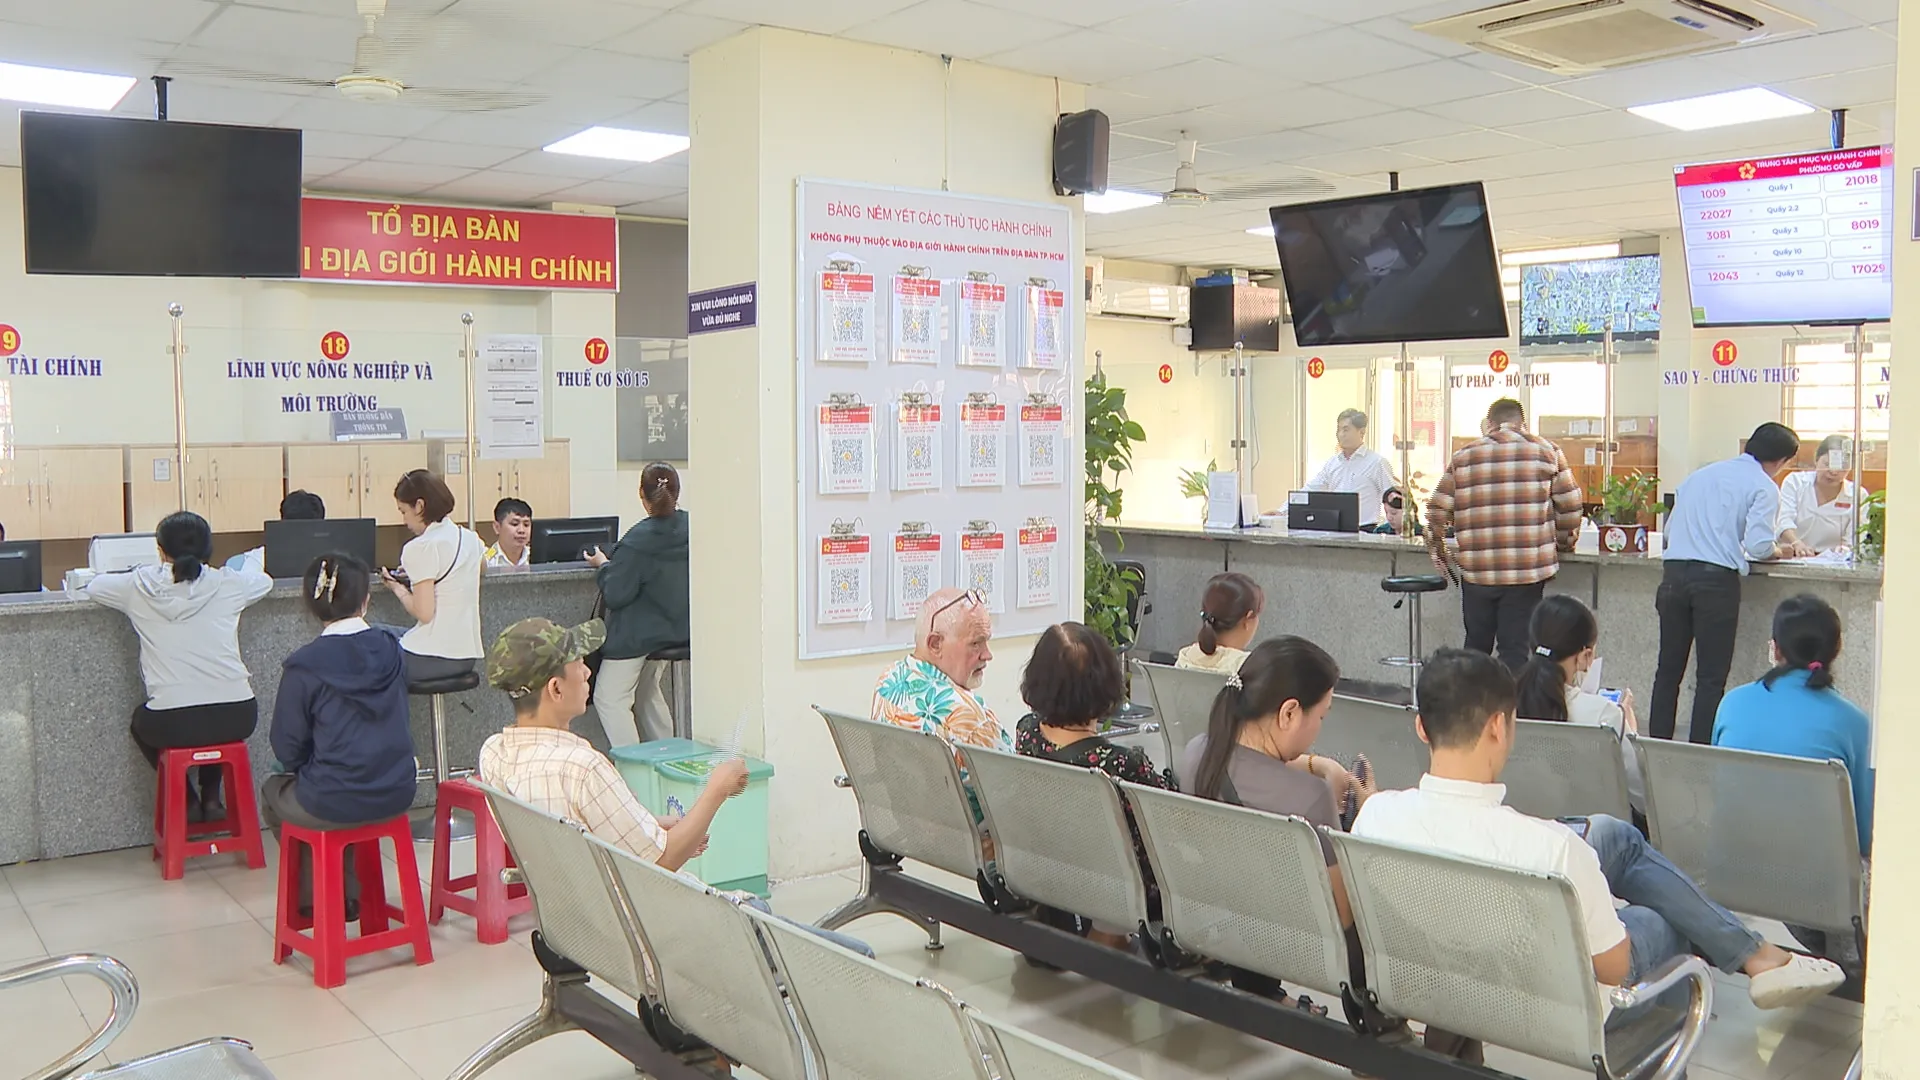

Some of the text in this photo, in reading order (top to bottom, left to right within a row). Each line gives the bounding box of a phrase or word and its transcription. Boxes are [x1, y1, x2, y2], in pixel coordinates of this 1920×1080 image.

[1782, 157, 1798, 166] TÂM
[1799, 156, 1820, 165] PHỤC
[1821, 155, 1832, 163] VỤ
[1834, 152, 1856, 160] HÀNH
[1845, 174, 1878, 186] 21018
[1701, 188, 1726, 199] 1009
[828, 200, 861, 219] BẢNG
[919, 209, 942, 227] CÁC
[944, 213, 965, 228] THỦ
[968, 216, 989, 232] TỤC
[992, 218, 1020, 235] HÀNH
[1022, 221, 1052, 238] CHÍNH
[1700, 209, 1732, 220] 22027
[1789, 204, 1799, 212] 2.2
[366, 204, 520, 243] TỔ ĐỊA BÀN
[1851, 219, 1879, 230] 8019
[810, 231, 841, 243] KHÔNG
[844, 234, 861, 247] PHỤ
[863, 236, 890, 248] THUỘC
[892, 237, 908, 249] VÀO
[910, 240, 923, 252] ĐỊA
[944, 242, 965, 254] HÀNH
[967, 243, 990, 255] CHÍNH
[1706, 230, 1731, 240] 3081
[321, 247, 371, 277] ĐỊA
[379, 246, 436, 276] GIỚI
[446, 249, 521, 279] HÀNH
[530, 254, 612, 283] CHÍNH
[1852, 263, 1886, 274] 17029
[1708, 271, 1739, 282] 12043
[691, 290, 753, 312] XIN VUI LÒNG NÓI NHỎ
[725, 311, 741, 323] NGHE
[324, 337, 346, 355] 18
[587, 343, 606, 360] 17
[1716, 344, 1734, 361] 11
[7, 354, 102, 377] TÀI CHÍNH
[227, 358, 433, 382] LĨNH VỰC NÔNG NGHIỆP VÀ
[1309, 360, 1324, 375] 13
[1490, 354, 1506, 369] 12
[556, 367, 593, 387] THUẾ
[596, 370, 611, 387] CƠ
[635, 371, 649, 387] 15
[1159, 368, 1172, 380] 14
[1449, 374, 1464, 388] TƯ
[1466, 372, 1495, 388] PHÁP
[1524, 372, 1550, 389] TỊCH
[1664, 370, 1688, 385] SAO
[1692, 370, 1700, 384] Y
[1713, 366, 1758, 384] CHỨNG
[281, 392, 378, 413] MÔI TRƯỜNG
